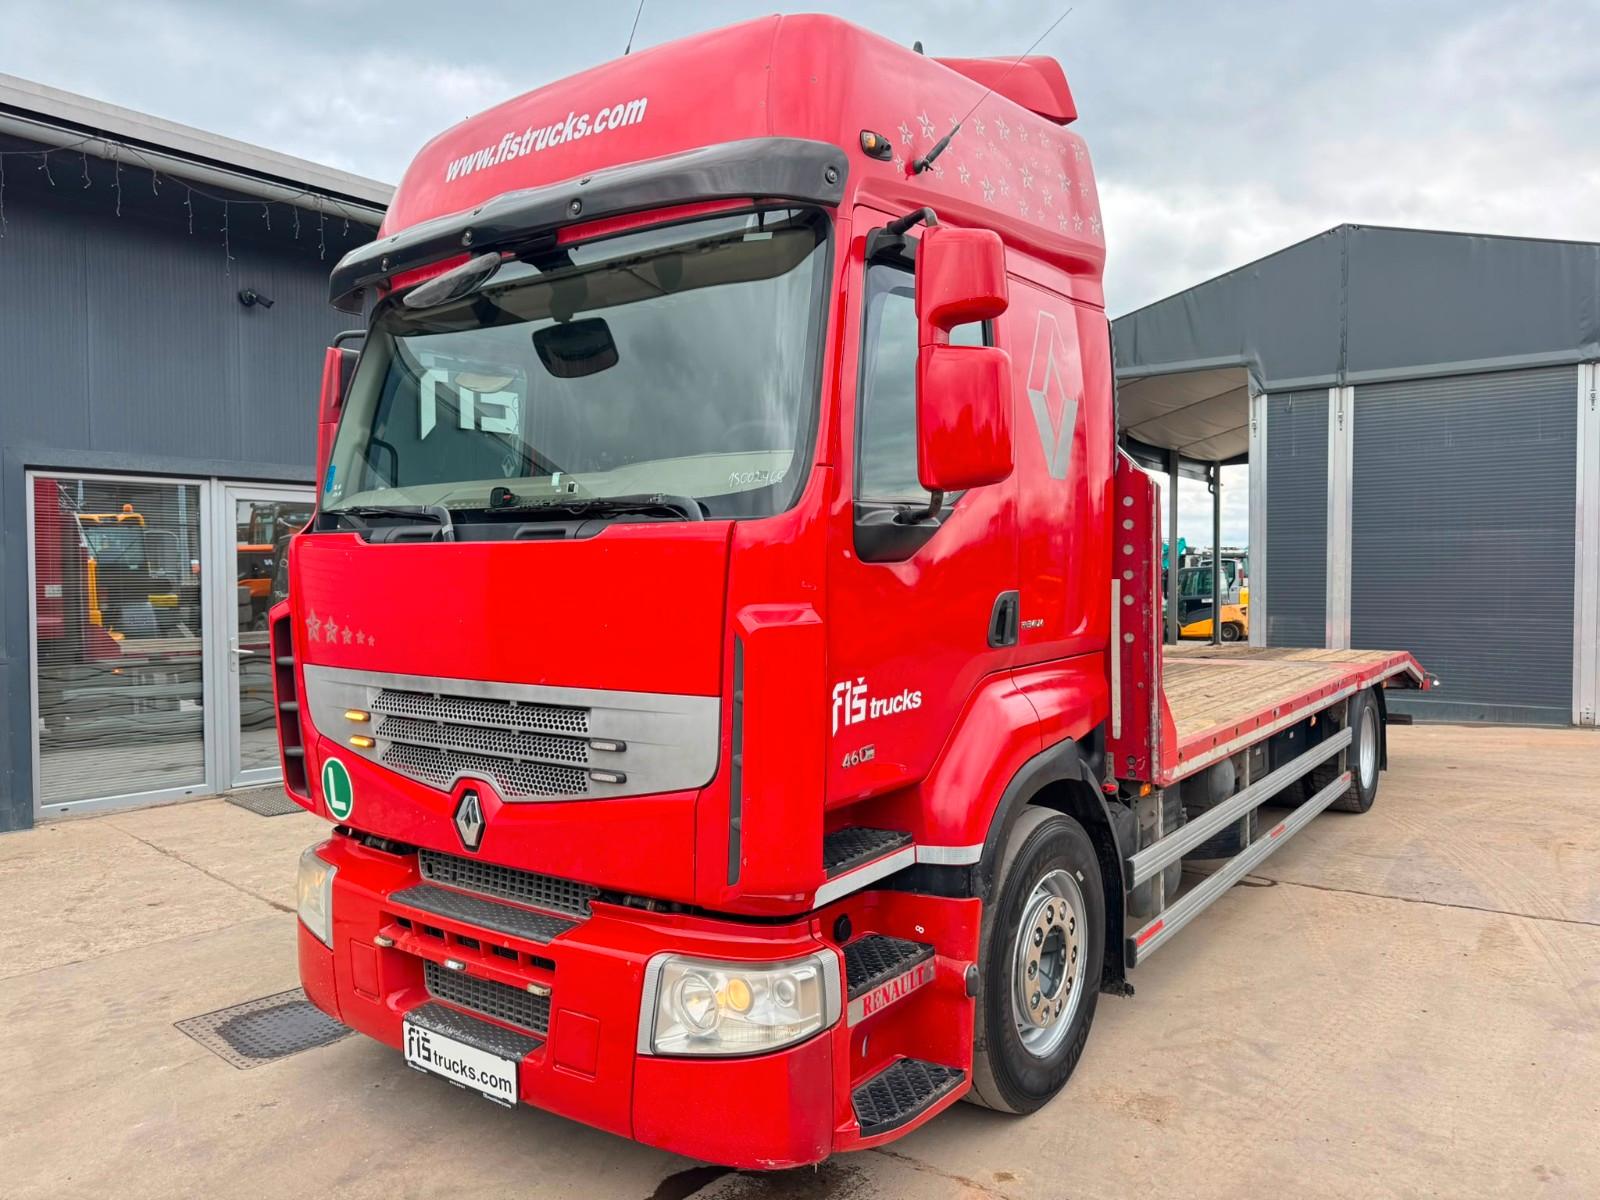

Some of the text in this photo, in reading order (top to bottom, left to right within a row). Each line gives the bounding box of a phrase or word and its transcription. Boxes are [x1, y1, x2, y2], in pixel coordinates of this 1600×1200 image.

[445, 97, 648, 183] www.fistrucks.com
[870, 688, 922, 719] trucks
[327, 766, 347, 811] L
[862, 966, 925, 1017] RENAULT
[433, 1050, 513, 1094] trucks.com
